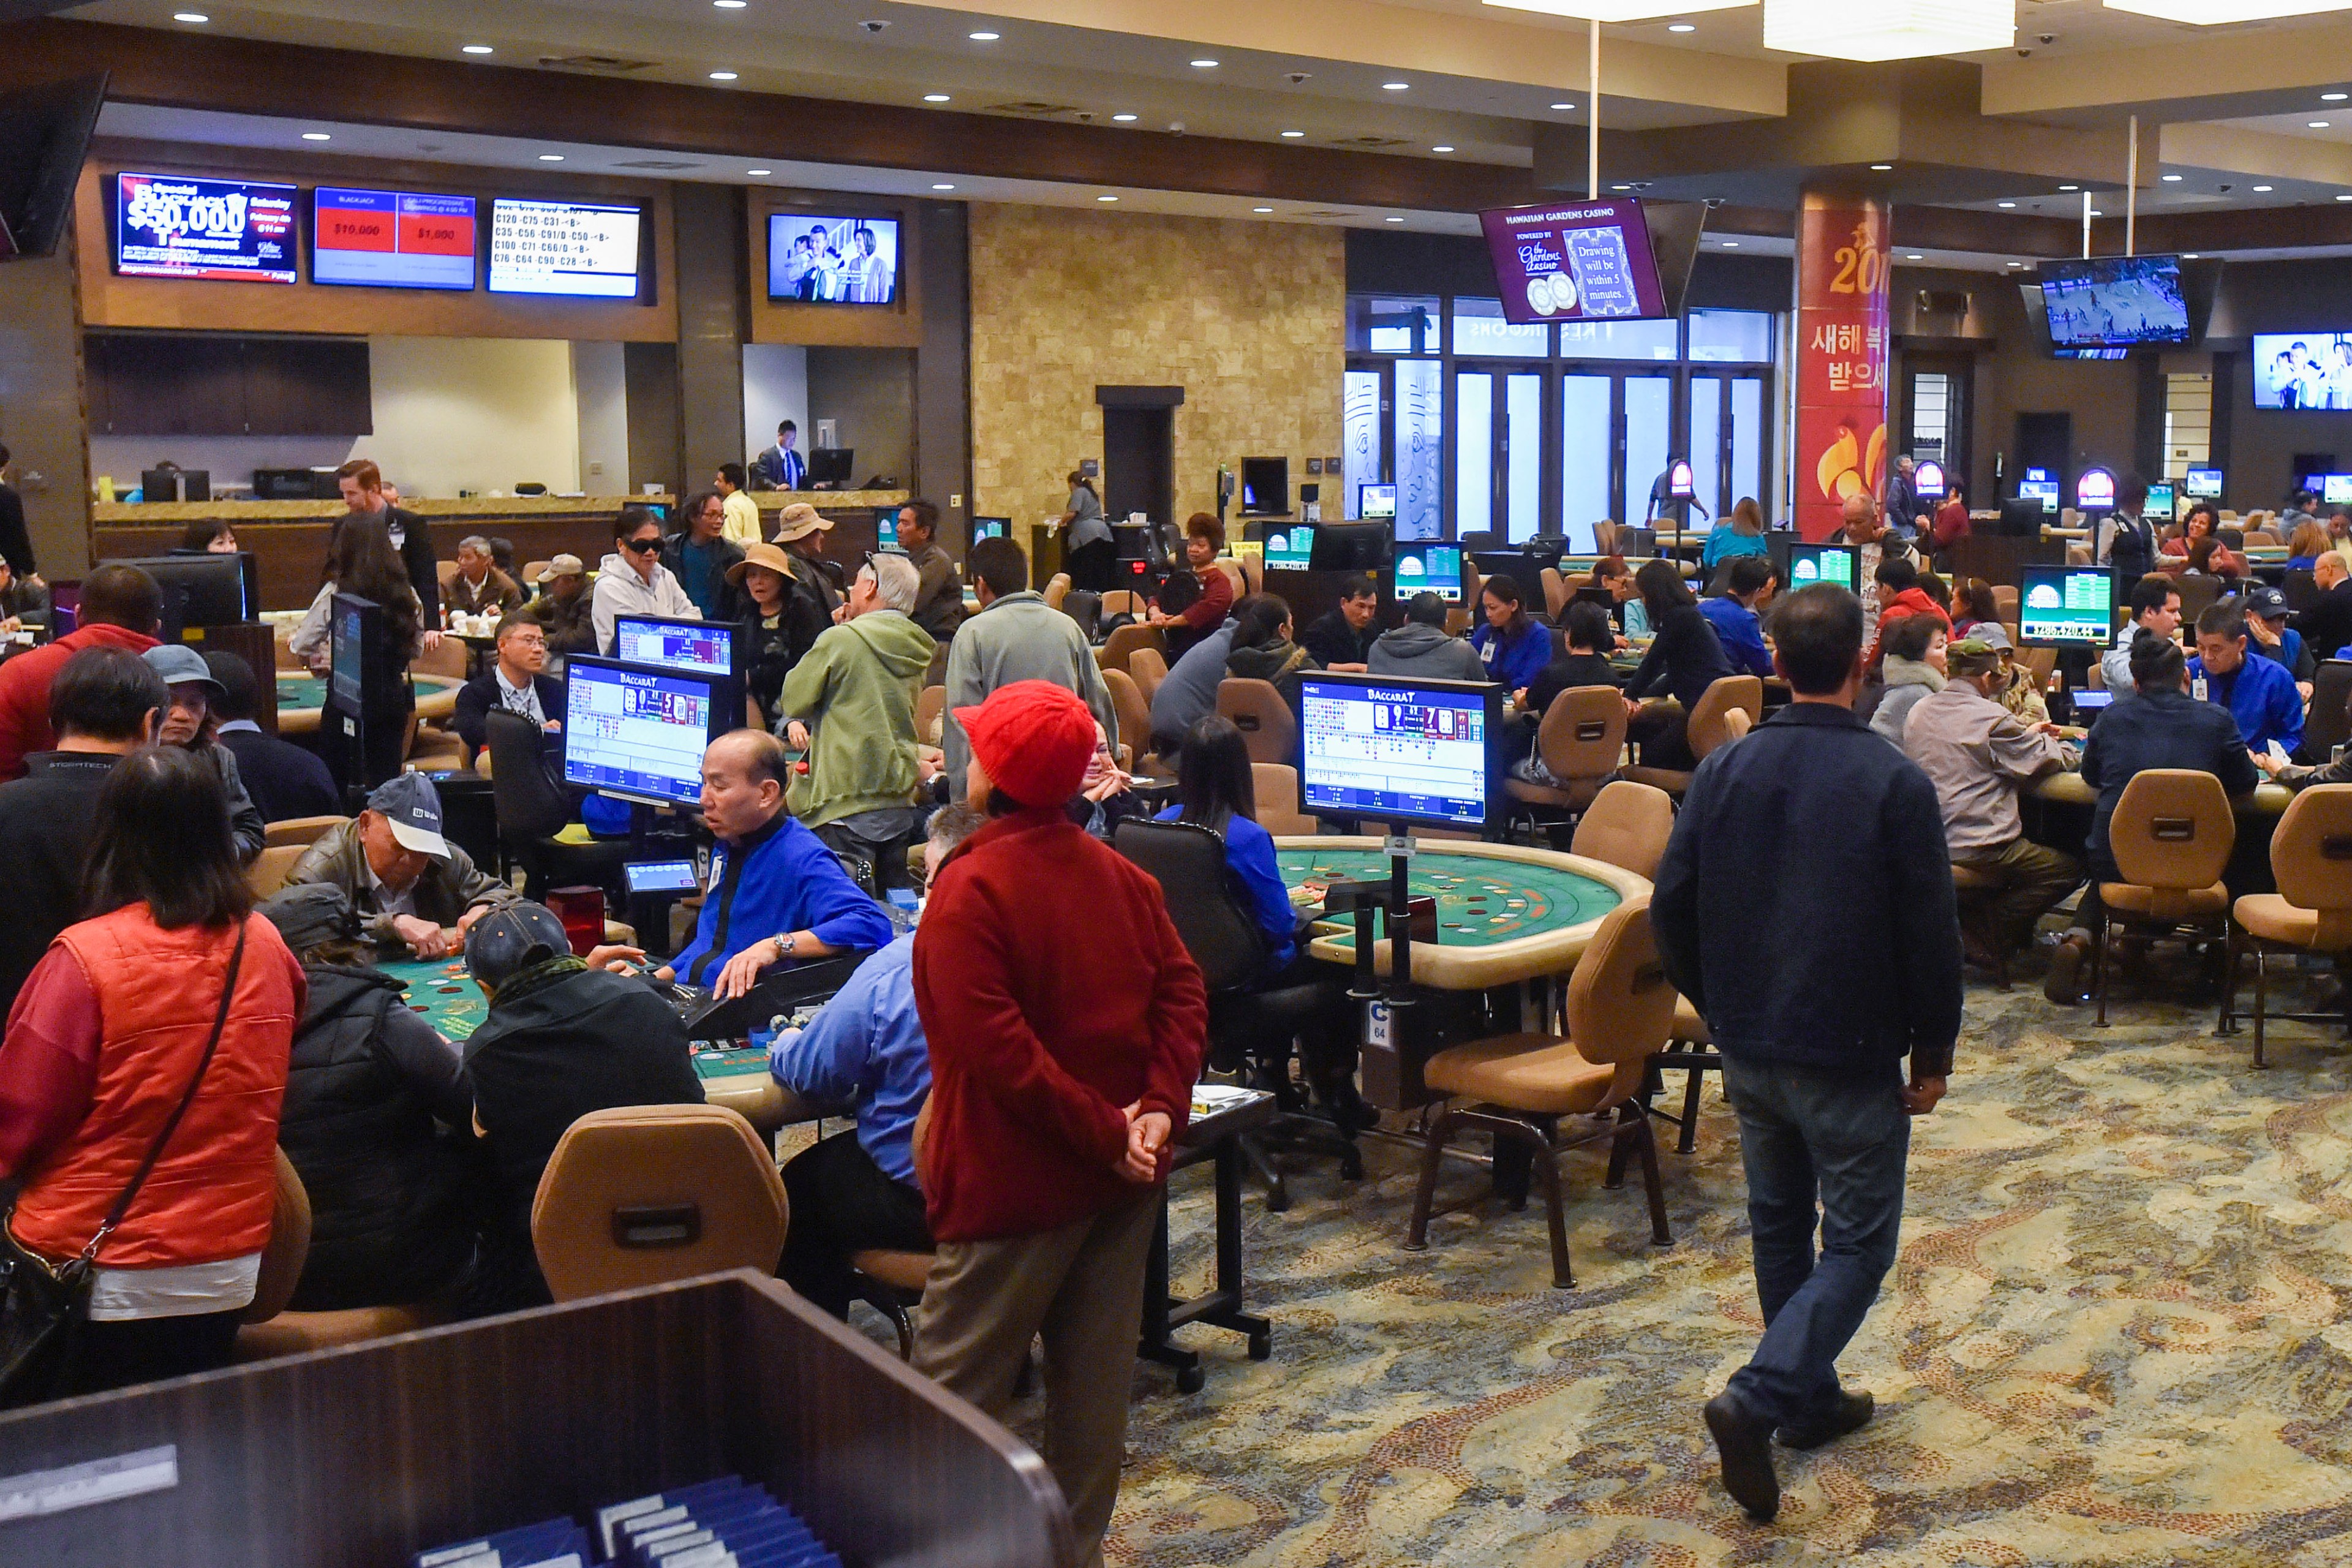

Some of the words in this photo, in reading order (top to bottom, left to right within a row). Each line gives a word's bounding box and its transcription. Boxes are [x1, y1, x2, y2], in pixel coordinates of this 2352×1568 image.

[339, 196, 375, 205] BLACKJACK
[127, 200, 245, 235] $50,000
[496, 214, 517, 224] C120
[1506, 214, 1544, 225] HAWAIIAN
[1546, 211, 1583, 221] GARDENS
[1583, 208, 1615, 218] CASINO
[335, 224, 379, 236] $10,000
[418, 228, 454, 239] $1,000
[495, 227, 512, 236] C35
[495, 240, 516, 250] C100
[1578, 245, 1615, 258] Drawing
[1585, 261, 1602, 271] will
[1603, 260, 1614, 270] be
[1830, 247, 1890, 294] 201
[1586, 274, 1613, 285] within
[1615, 274, 1620, 284] 5
[1589, 289, 1624, 300] minutes.
[1811, 324, 1861, 355] 새해
[1828, 361, 1885, 391] 받으세
[659, 627, 688, 637] BACCARAT
[2034, 625, 2094, 637] $286,420.44
[620, 673, 657, 688] BACCARAT
[665, 693, 672, 709] 5
[1367, 688, 1415, 704] BACCARAT
[1393, 704, 1402, 722] 9
[1427, 707, 1436, 724] 7
[1371, 1004, 1388, 1022] C
[1374, 1027, 1385, 1039] 64
